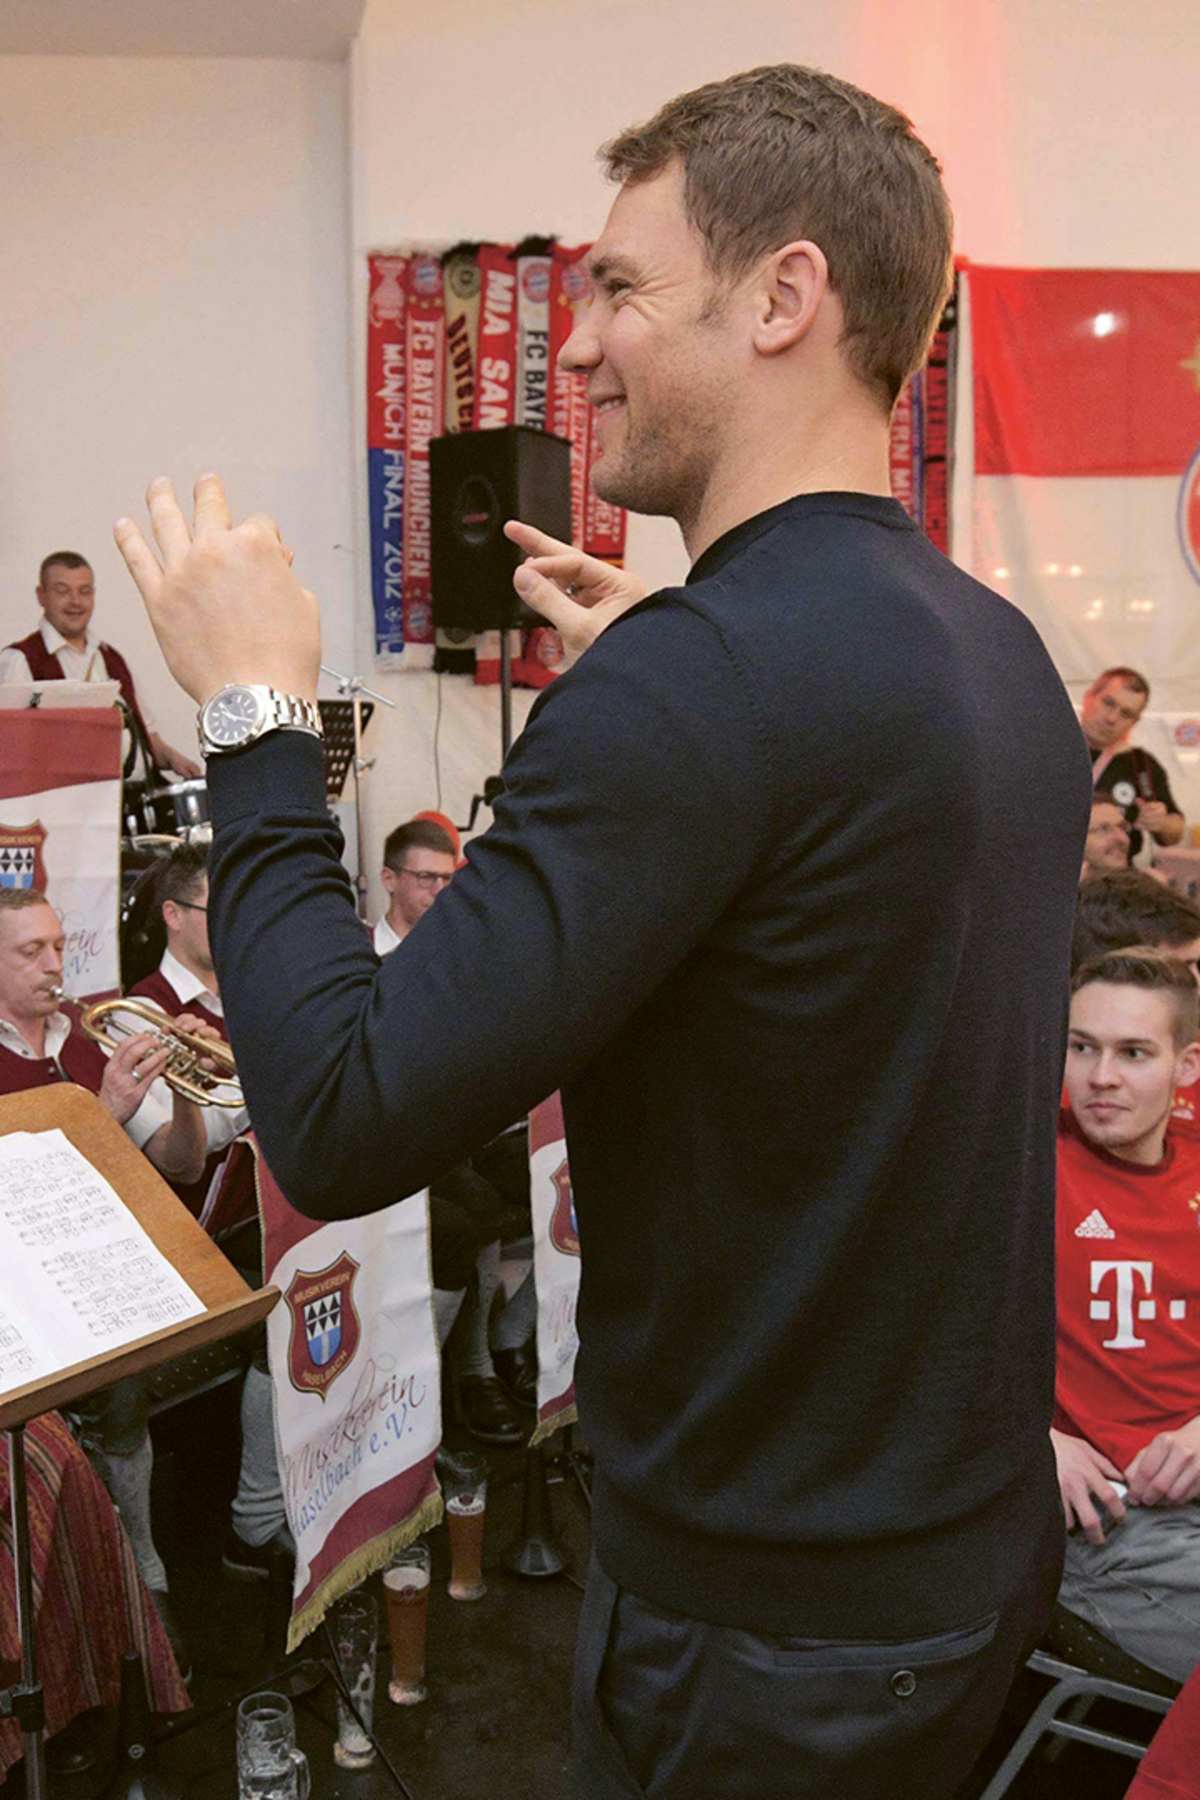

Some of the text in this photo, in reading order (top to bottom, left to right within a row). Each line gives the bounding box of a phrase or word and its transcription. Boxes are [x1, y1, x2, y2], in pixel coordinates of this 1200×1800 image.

[411, 320, 435, 351] FC
[479, 269, 515, 429] MIA SAN
[525, 329, 547, 359] FC
[409, 358, 433, 451] BAYERN
[375, 343, 405, 600] MUNICH FINAL 2012
